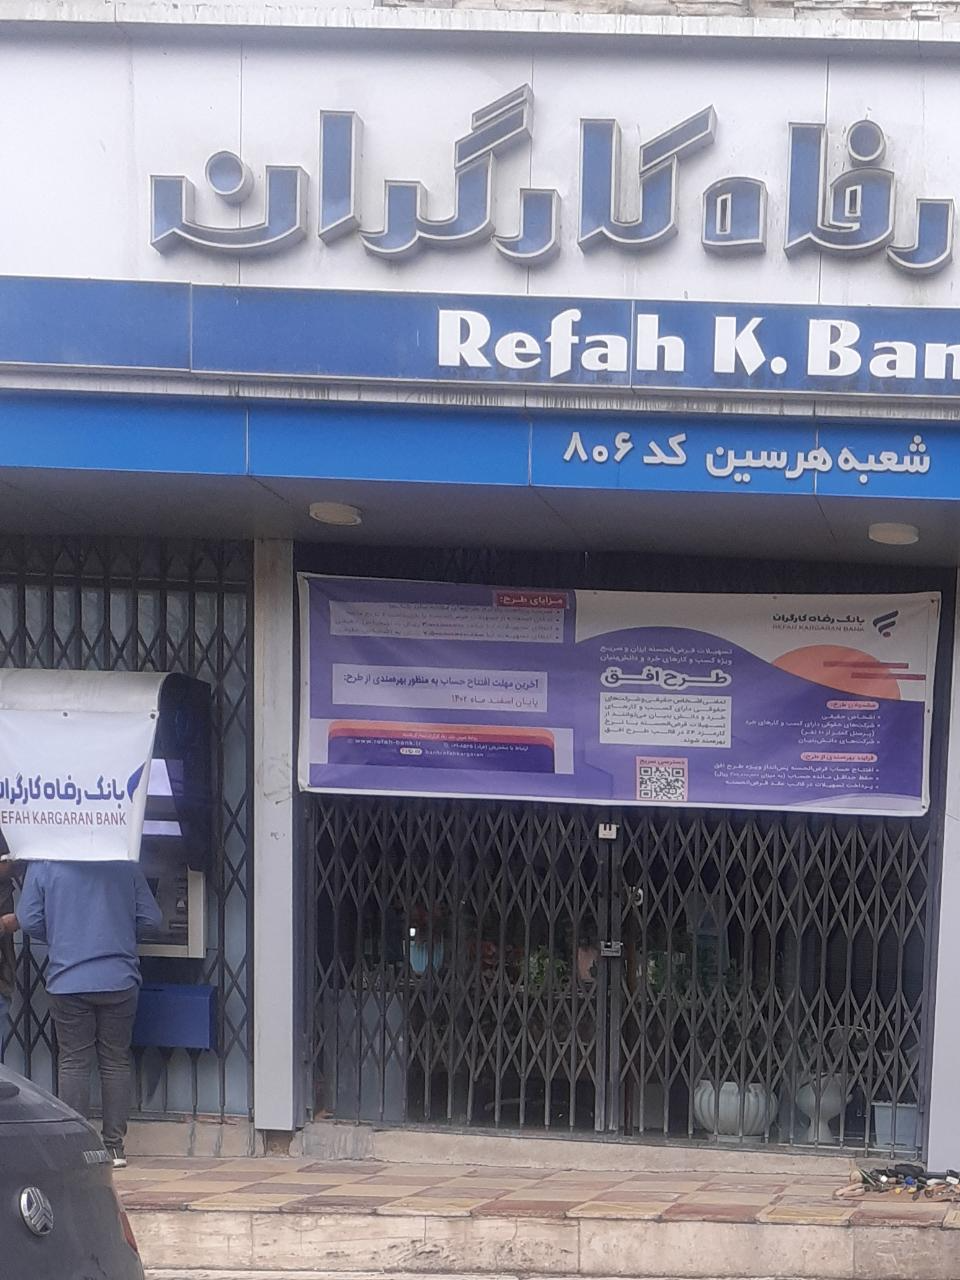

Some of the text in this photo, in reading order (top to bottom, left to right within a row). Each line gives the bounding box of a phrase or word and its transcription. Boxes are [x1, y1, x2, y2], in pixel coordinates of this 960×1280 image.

[150, 84, 718, 267] کارگران
[703, 119, 955, 275] رفاه
[437, 307, 685, 379] Refah
[713, 315, 787, 375] K.
[562, 431, 931, 484] شعبه هرسین کد ۸۰۶
[773, 613, 864, 626] بانک رفاه کارگران
[605, 668, 728, 687] طرح افق
[44, 774, 81, 805] رفاه
[84, 776, 125, 809] بانک
[1, 810, 127, 825] EFAH KARGARAN BANK
